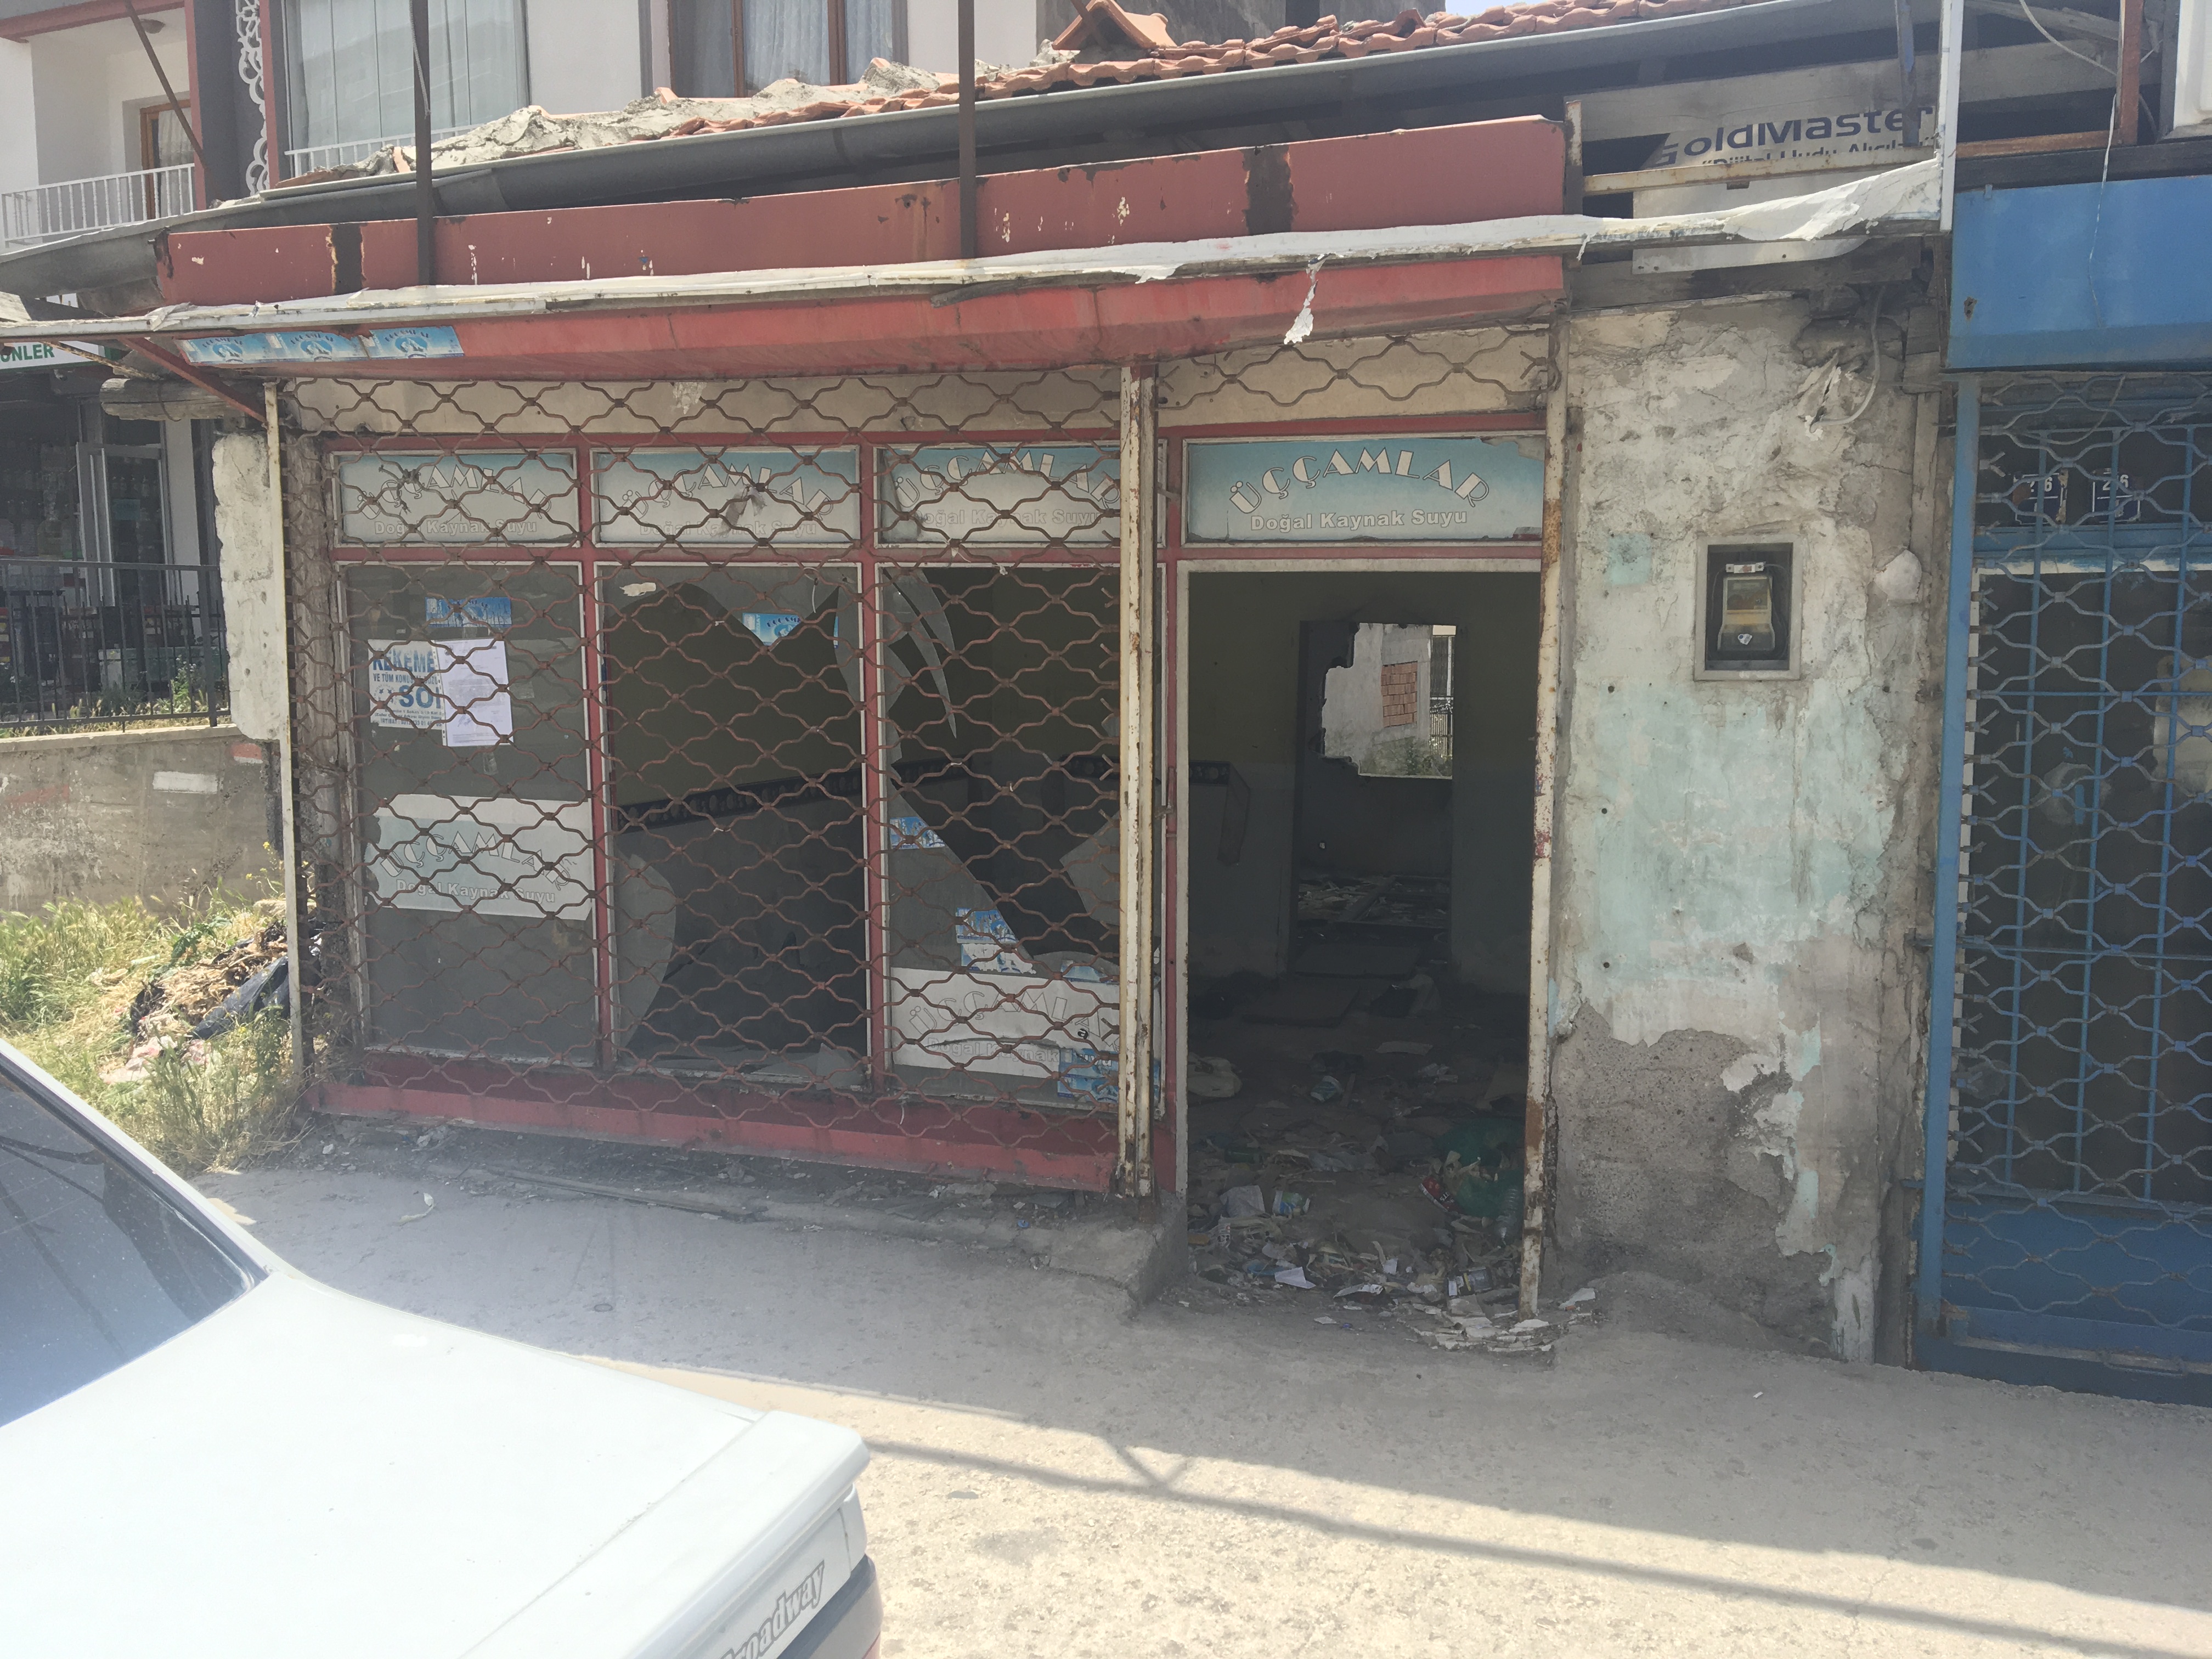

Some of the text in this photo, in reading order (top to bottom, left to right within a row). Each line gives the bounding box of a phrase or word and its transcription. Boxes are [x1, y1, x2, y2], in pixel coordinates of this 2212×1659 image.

[1229, 447, 1489, 514] ÜÇÇAMLAR
[1251, 509, 1468, 532] Doğal Kaynak Suyu
